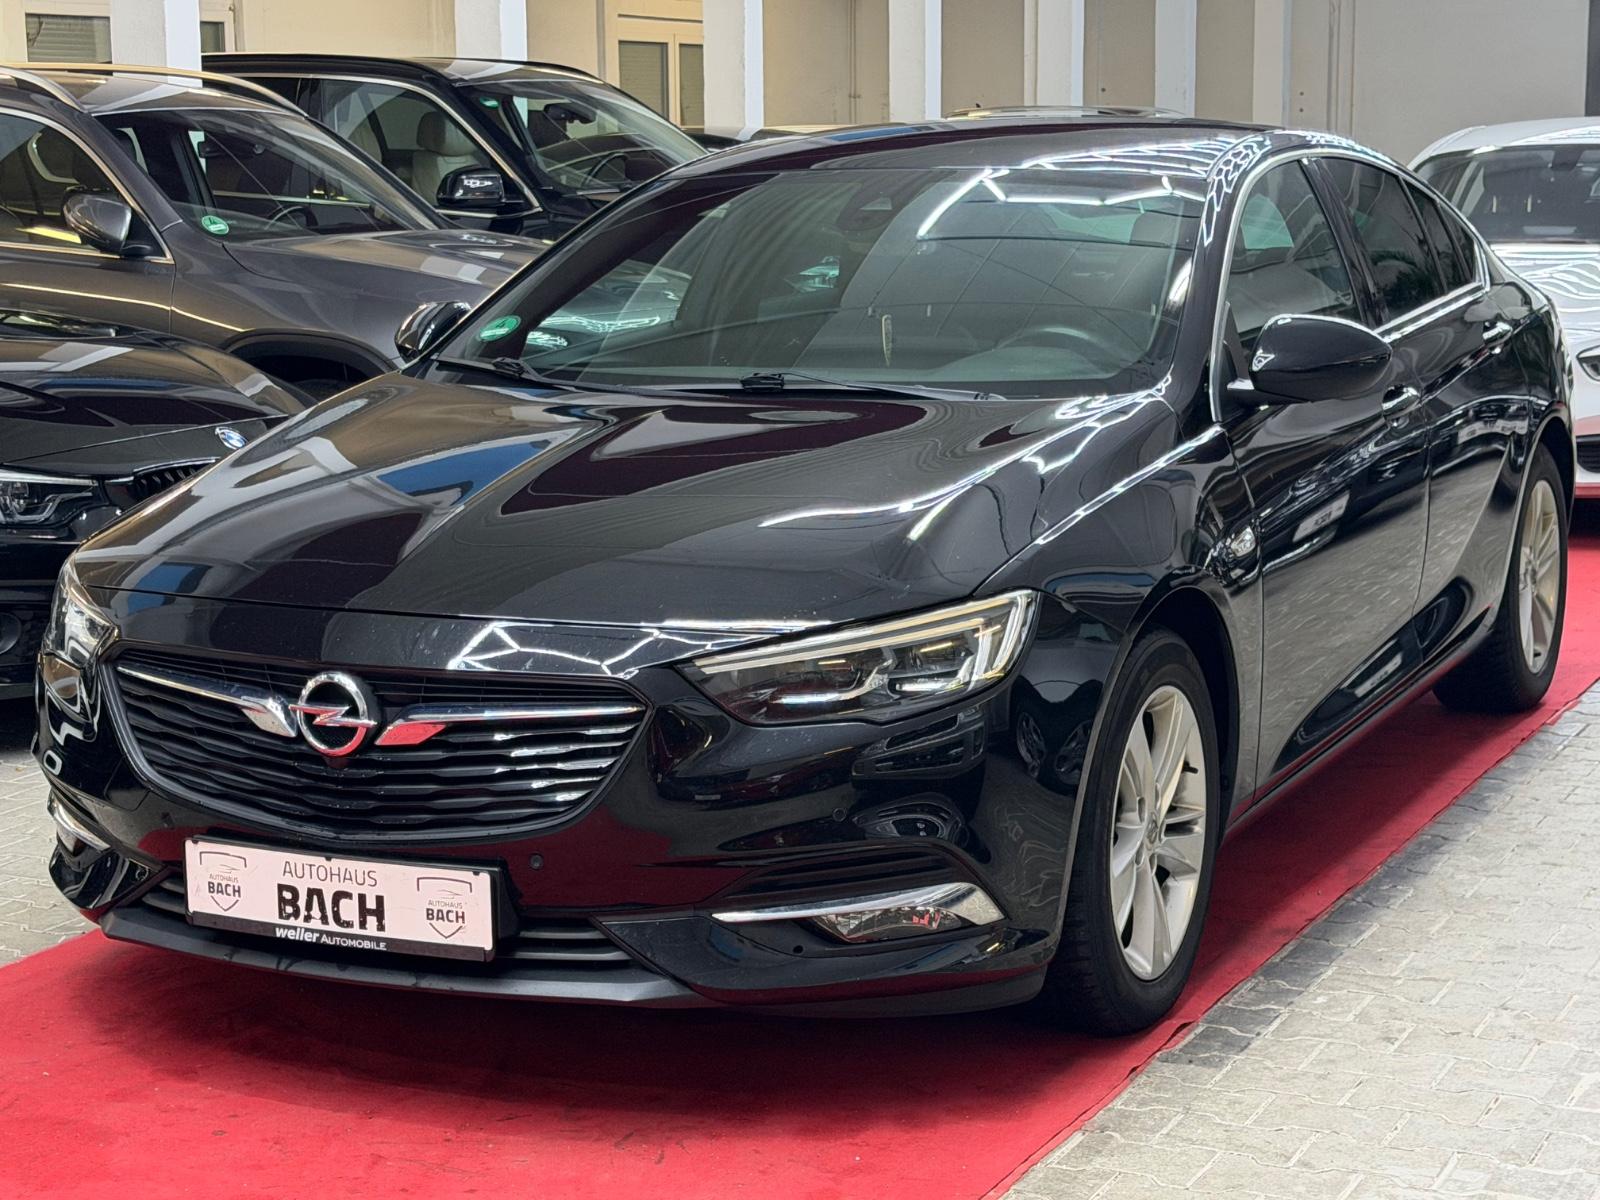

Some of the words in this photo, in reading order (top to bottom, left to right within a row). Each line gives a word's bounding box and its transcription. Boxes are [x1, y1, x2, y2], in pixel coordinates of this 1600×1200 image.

[209, 873, 239, 883] AUTOHAUS
[282, 860, 378, 887] AUTOHAUS
[207, 881, 241, 898] BACH
[277, 883, 386, 932] BACH
[428, 900, 463, 909] AUTOHAUS
[426, 907, 465, 924] BACH
[275, 927, 320, 943] weller
[320, 934, 388, 951] AUTOMOBILE
